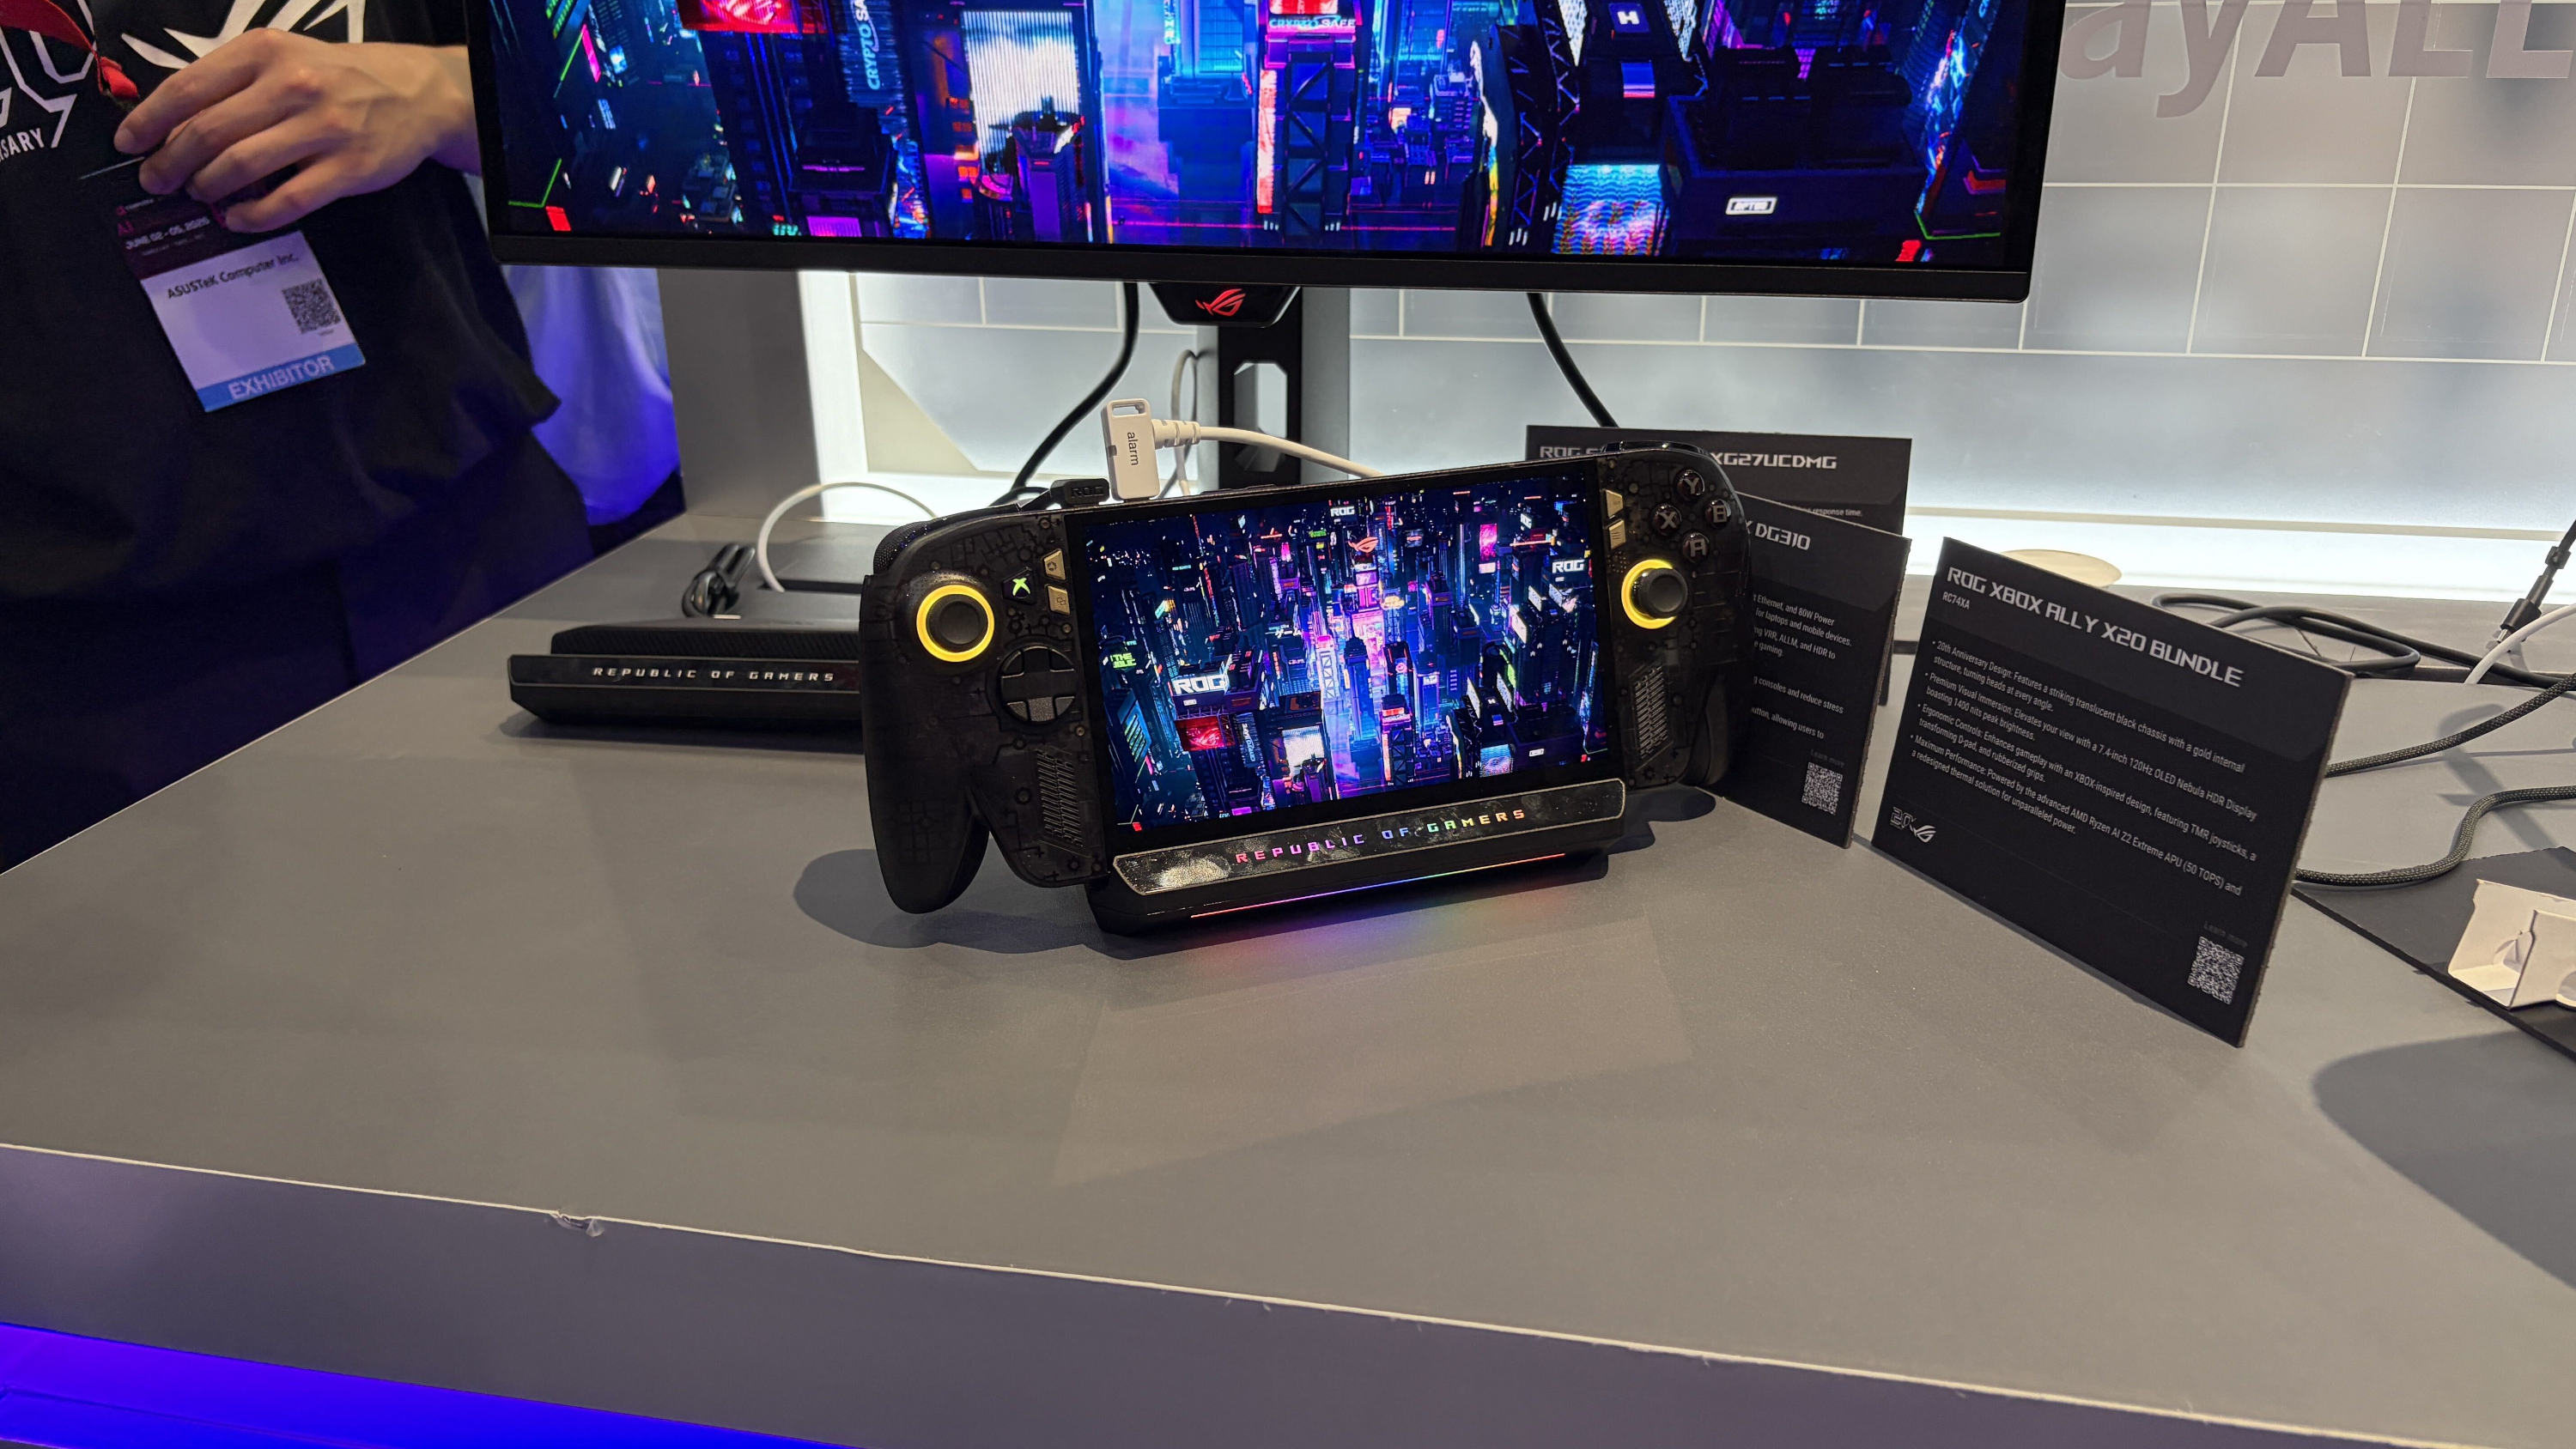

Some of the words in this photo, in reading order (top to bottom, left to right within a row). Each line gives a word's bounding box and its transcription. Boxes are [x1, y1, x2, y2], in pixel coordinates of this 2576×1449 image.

[1269, 19, 1319, 28] CRYPTO
[1321, 19, 1357, 27] SAFE
[859, 23, 881, 90] CRYPTO
[2060, 0, 2574, 118] ayALL
[0, 128, 45, 161] SARY
[167, 276, 218, 299] ASUSTeK
[218, 256, 276, 283] Computer
[228, 355, 335, 400] EXHIBITOR
[1127, 432, 1139, 466] alarm
[1710, 452, 1837, 470] XG27UCDMG
[1684, 477, 1699, 494] Y
[1330, 506, 1355, 517] ROG
[1659, 511, 1677, 529] X
[1711, 505, 1728, 524] B
[1690, 537, 1707, 557] A
[1754, 522, 1810, 550] DG310
[1552, 559, 1586, 573] ROG
[1757, 594, 1783, 611] Ethernet,
[1784, 604, 1797, 614] and
[1798, 607, 1814, 619] 80W
[1814, 612, 1835, 626] Power
[1942, 591, 1970, 609] RC74XA
[1764, 628, 1777, 641] VRR,
[1778, 634, 1798, 648] ALLM,
[1799, 642, 1812, 652] and
[1812, 645, 1827, 657] HDR
[1828, 650, 1835, 659] to
[1765, 610, 1788, 625] laptops
[1789, 620, 1801, 629] and
[1801, 624, 1825, 637] mobile
[1825, 630, 1851, 646] devices.
[1947, 567, 1987, 593] ROG
[1989, 581, 2044, 614] XBOX
[2044, 602, 2099, 633] ALLY
[2100, 621, 2147, 652] X20
[2148, 639, 2243, 687] BUNDLE
[1759, 642, 1783, 657] gaming.
[592, 667, 697, 679] REPUBLIC
[711, 670, 736, 679] OF
[749, 670, 835, 682] GAMERS
[1174, 674, 1226, 694] ROG
[1933, 656, 1962, 674] structure,
[1963, 666, 1985, 685] turning
[1985, 675, 2006, 691] heads
[2006, 686, 2014, 694] at
[2014, 689, 2032, 704] every
[2032, 697, 2053, 712] angle.
[1759, 678, 1786, 693] consoles
[1787, 688, 1800, 698] and
[1800, 692, 1822, 706] reduce
[1822, 700, 1844, 713] stress
[1936, 640, 1951, 653] 20th
[1951, 646, 1988, 670] Anniversary
[1988, 661, 2013, 678] Design:
[2013, 671, 2042, 690] Features
[2048, 688, 2075, 706] striking
[2075, 697, 2116, 721] translucent
[2116, 712, 2136, 729] black
[2137, 723, 2166, 742] chassis
[2168, 736, 2184, 749] with
[2185, 743, 2191, 752] a
[2192, 746, 2212, 760] gold
[2212, 752, 2245, 773] internal
[1771, 712, 1797, 731] allowing
[1797, 724, 1815, 736] users
[1816, 730, 1824, 738] to
[1926, 685, 1953, 706] boasting
[1953, 697, 1970, 711] 1400
[1969, 706, 1982, 717] nits
[1982, 712, 1999, 724] peak
[1999, 717, 2035, 740] brightness.
[1918, 718, 1958, 743] transforming
[1958, 734, 1977, 751] D-pad,
[1978, 746, 1991, 756] and
[1991, 752, 2026, 773] rubberized
[2026, 767, 2045, 782] grips.
[1929, 672, 1956, 691] Premium
[1958, 683, 1978, 700] Visual
[1977, 693, 2013, 715] Immersion:
[2014, 707, 2042, 727] Elevates
[2041, 722, 2058, 734] your
[2059, 729, 2075, 741] view
[2075, 736, 2091, 749] with
[2098, 743, 2128, 764] 7.4-inch
[2129, 757, 2154, 775] 120Hz
[2154, 768, 2176, 785] OLED
[2176, 778, 2205, 797] Nebula
[2205, 790, 2225, 806] HDR
[2225, 798, 2257, 821] Display
[1917, 752, 1950, 773] redesigned
[1950, 767, 1975, 785] thermal
[1974, 779, 2000, 797] solution
[2001, 790, 2011, 802] for
[2011, 797, 2053, 822] unparalleled
[2051, 817, 2075, 834] power.
[1922, 703, 1954, 724] Ergonomic
[1954, 718, 1983, 737] Controls:
[1983, 731, 2014, 752] Enhances
[2014, 747, 2048, 768] gameplay
[2048, 761, 2063, 774] with
[2063, 769, 2073, 779] an
[2074, 771, 2125, 802] XBOX-inspired
[2125, 795, 2152, 815] design,
[2154, 807, 2189, 833] featuring
[2190, 823, 2209, 840] TMR
[2208, 833, 2248, 858] joysticks,
[2249, 852, 2257, 861] a
[1914, 734, 1944, 755] Maximum
[1944, 748, 1986, 774] Performance:
[1986, 767, 2015, 788] Powered
[2015, 781, 2025, 794] by
[2025, 786, 2036, 798] the
[2036, 793, 2070, 814] advanced
[2069, 808, 2088, 822] AMD
[2088, 815, 2111, 834] Ryzen
[2111, 828, 2120, 838] AI
[2120, 831, 2132, 844] Z2
[2131, 836, 2164, 858] Extreme
[2163, 852, 2183, 867] APU
[2183, 860, 2197, 874] (50
[2198, 867, 2224, 888] TOPS)
[2224, 882, 2242, 895] and
[1235, 834, 1365, 864] REPUBLIC
[1382, 827, 1410, 840] OF
[1426, 809, 1526, 834] GAMERS
